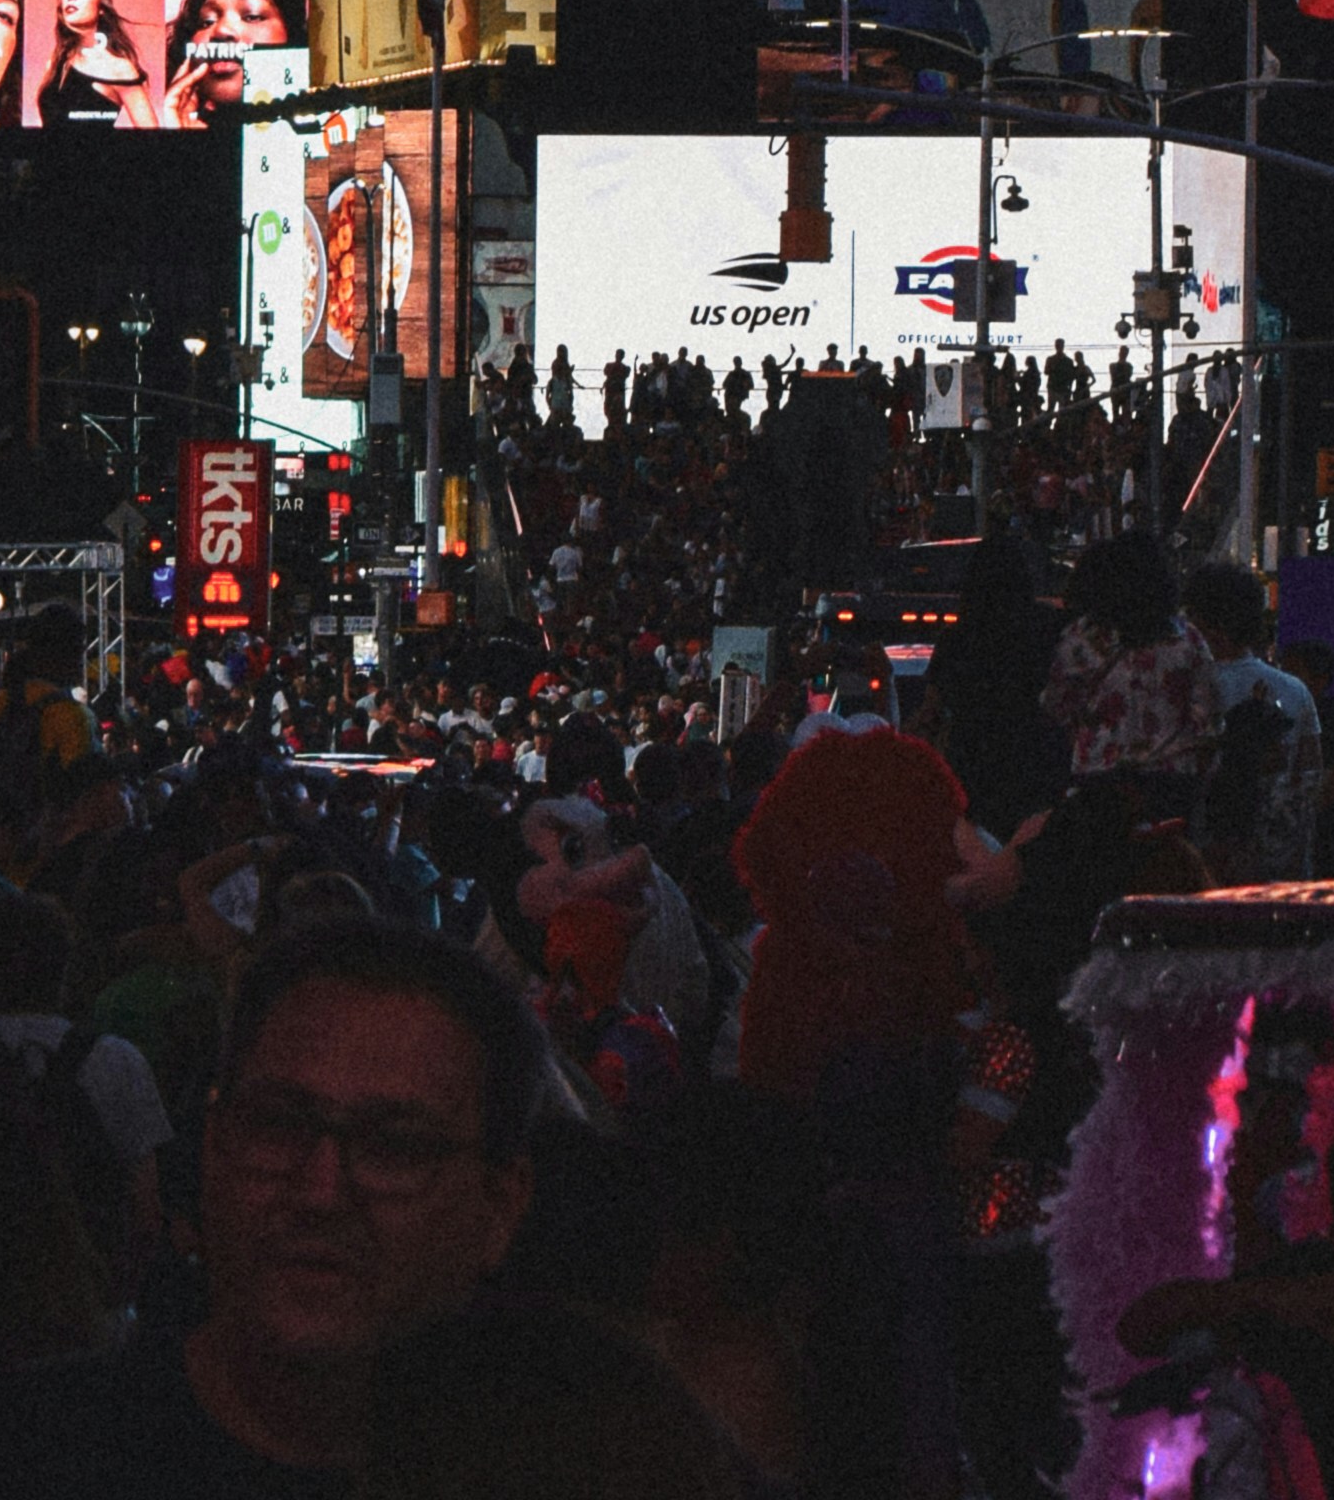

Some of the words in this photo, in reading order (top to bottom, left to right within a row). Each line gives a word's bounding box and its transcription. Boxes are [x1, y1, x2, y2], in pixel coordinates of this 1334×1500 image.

[689, 305, 725, 327] us
[731, 300, 811, 334] open
[897, 333, 961, 345] OFFICIAL
[968, 334, 1024, 345] YGURT
[200, 448, 257, 564] tkts
